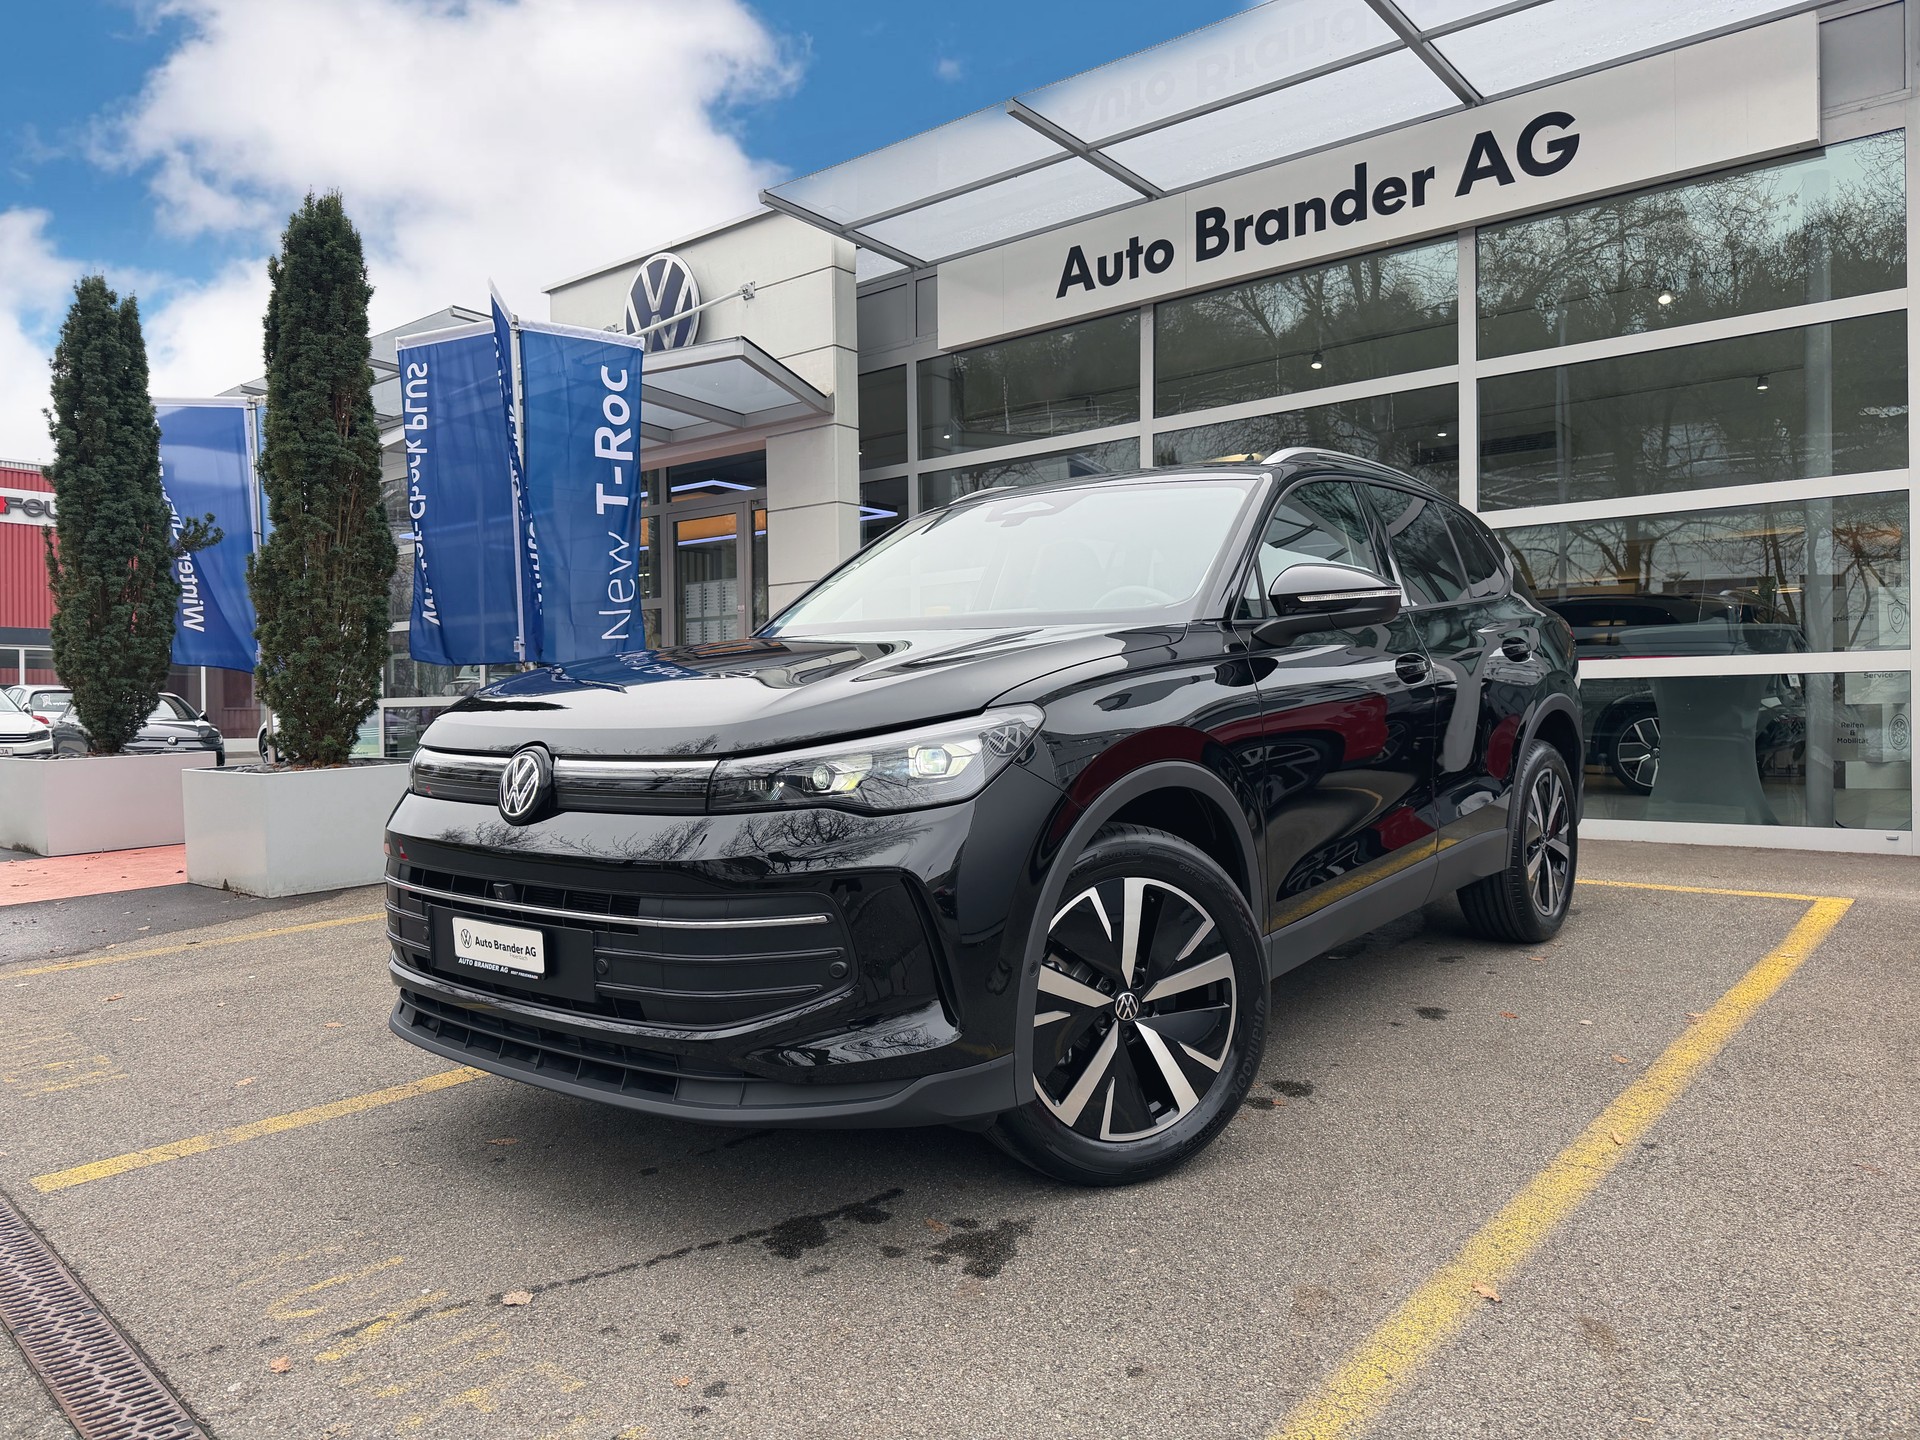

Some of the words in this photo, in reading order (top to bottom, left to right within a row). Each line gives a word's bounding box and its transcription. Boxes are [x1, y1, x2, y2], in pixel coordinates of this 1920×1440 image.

[1056, 236, 1175, 298] Auto
[1195, 161, 1436, 263] Brander
[1455, 111, 1580, 197] AG
[594, 364, 634, 515] T-Roc
[598, 531, 636, 640] New
[1840, 721, 1865, 729] Reifen
[458, 957, 473, 967] AUTO
[474, 960, 500, 972] BRANDER
[500, 965, 509, 974] AG
[475, 936, 493, 949] Auto
[494, 940, 523, 955] Brander
[525, 945, 537, 957] AG
